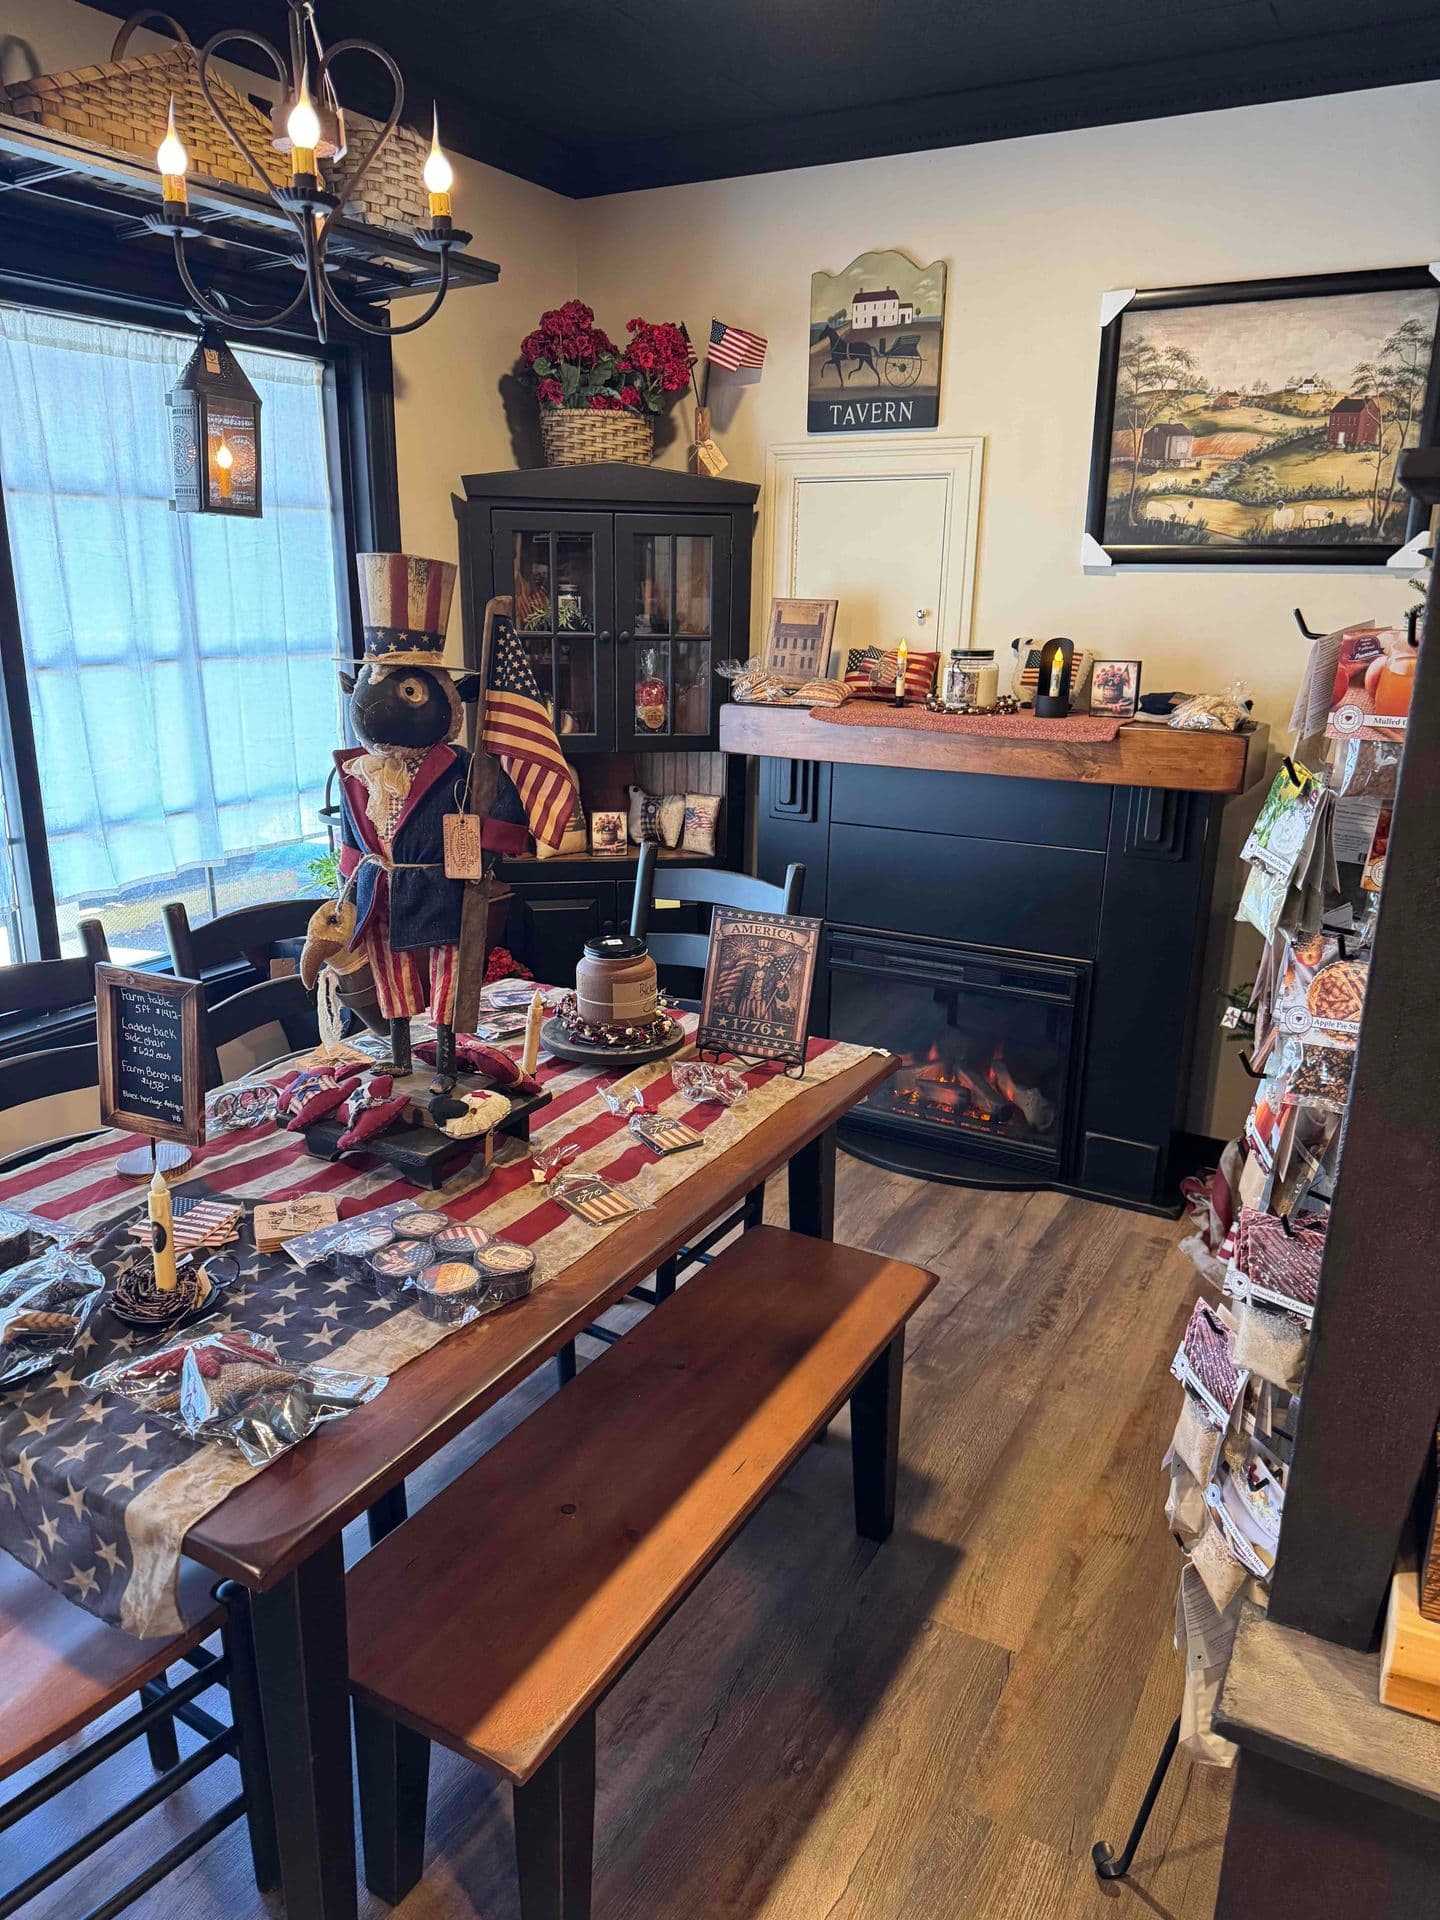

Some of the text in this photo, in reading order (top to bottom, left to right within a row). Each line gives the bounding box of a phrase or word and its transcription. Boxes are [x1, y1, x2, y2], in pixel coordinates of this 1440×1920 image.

[829, 400, 915, 426] TAVERN
[1373, 716, 1401, 726] Mulled
[731, 923, 796, 942] AMERICA
[120, 987, 174, 1008] Farm table
[731, 1017, 772, 1036] 1776
[1313, 1019, 1336, 1029] Apple
[1336, 1021, 1348, 1031] Pie
[155, 1052, 172, 1061] each
[121, 1059, 145, 1075] Farm
[145, 1065, 170, 1081] Bench
